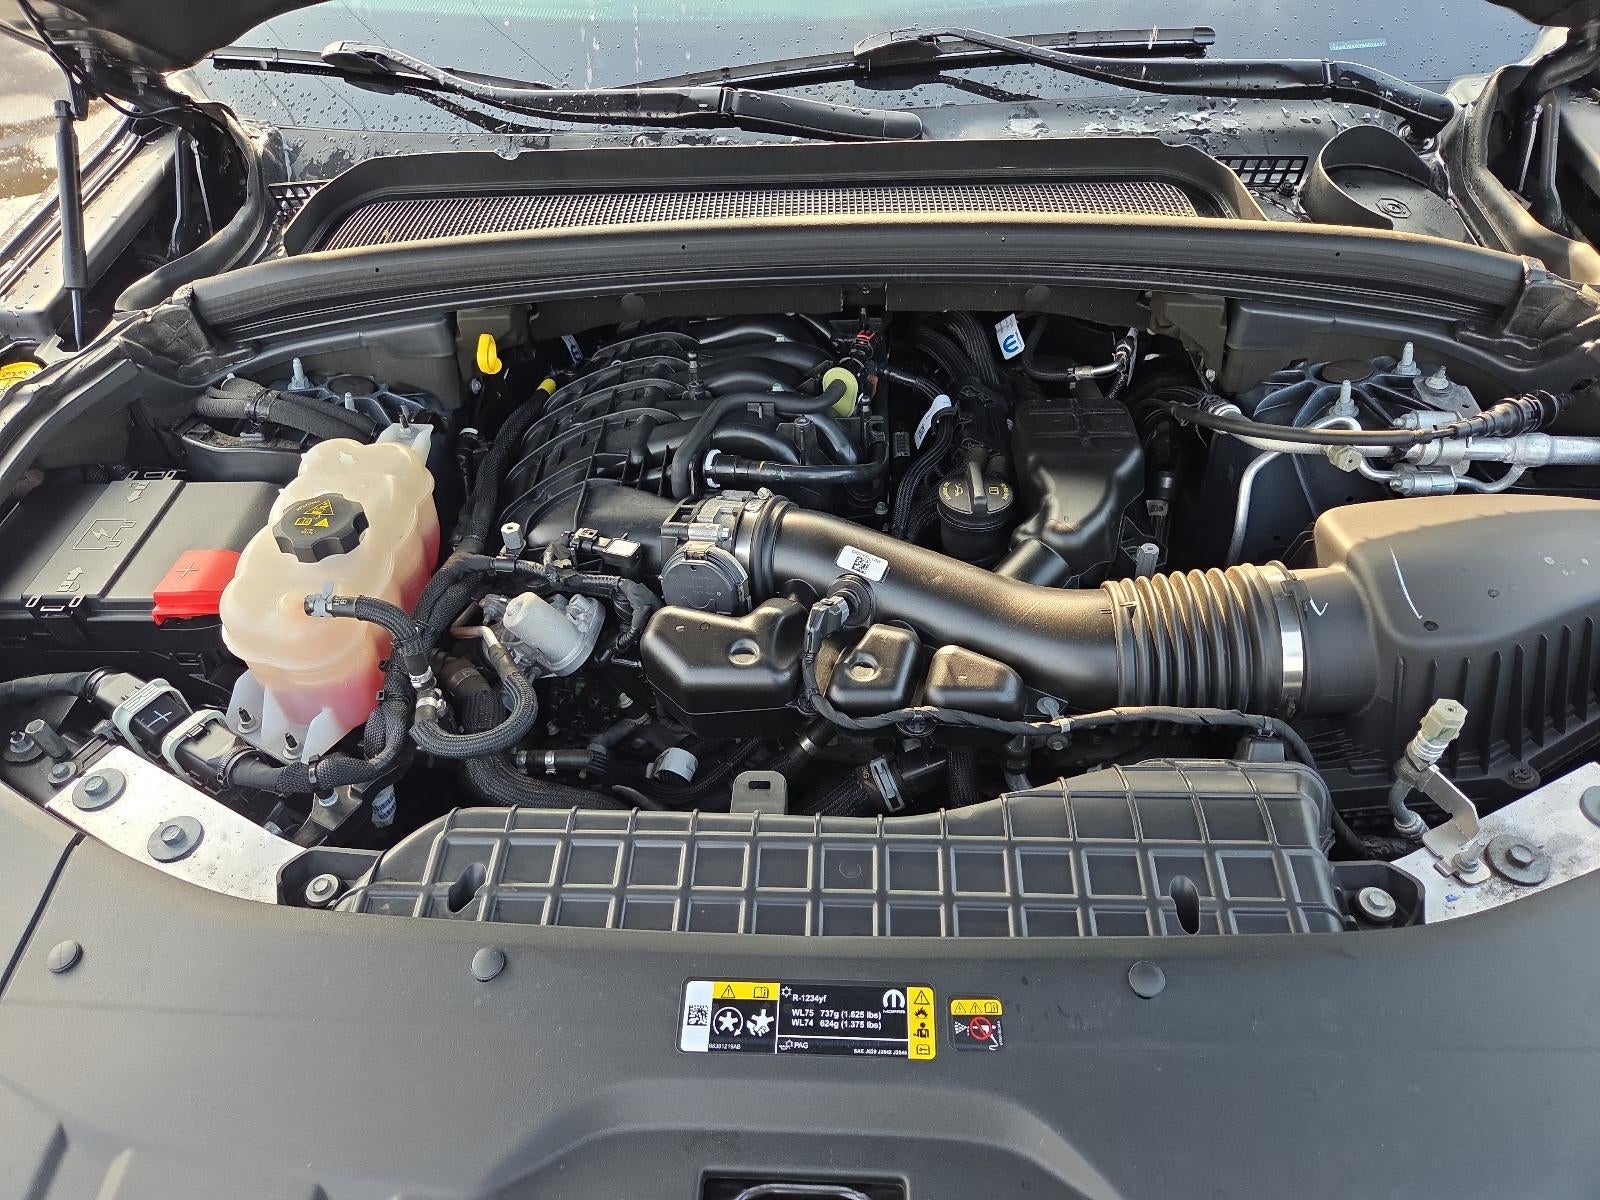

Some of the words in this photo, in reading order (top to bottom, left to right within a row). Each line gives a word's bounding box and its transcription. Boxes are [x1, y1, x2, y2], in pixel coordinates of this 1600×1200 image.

[792, 994, 828, 1004] R-1234yf
[791, 1008, 815, 1017] WL75
[820, 1009, 840, 1019] 737g
[841, 1010, 865, 1019] (1.625
[866, 1011, 882, 1020] lbs)
[791, 1018, 814, 1027] WL74
[819, 1019, 840, 1030] 624g
[840, 1020, 865, 1029] (1.375
[866, 1020, 882, 1031] lbs)
[793, 1041, 809, 1049] PAG
